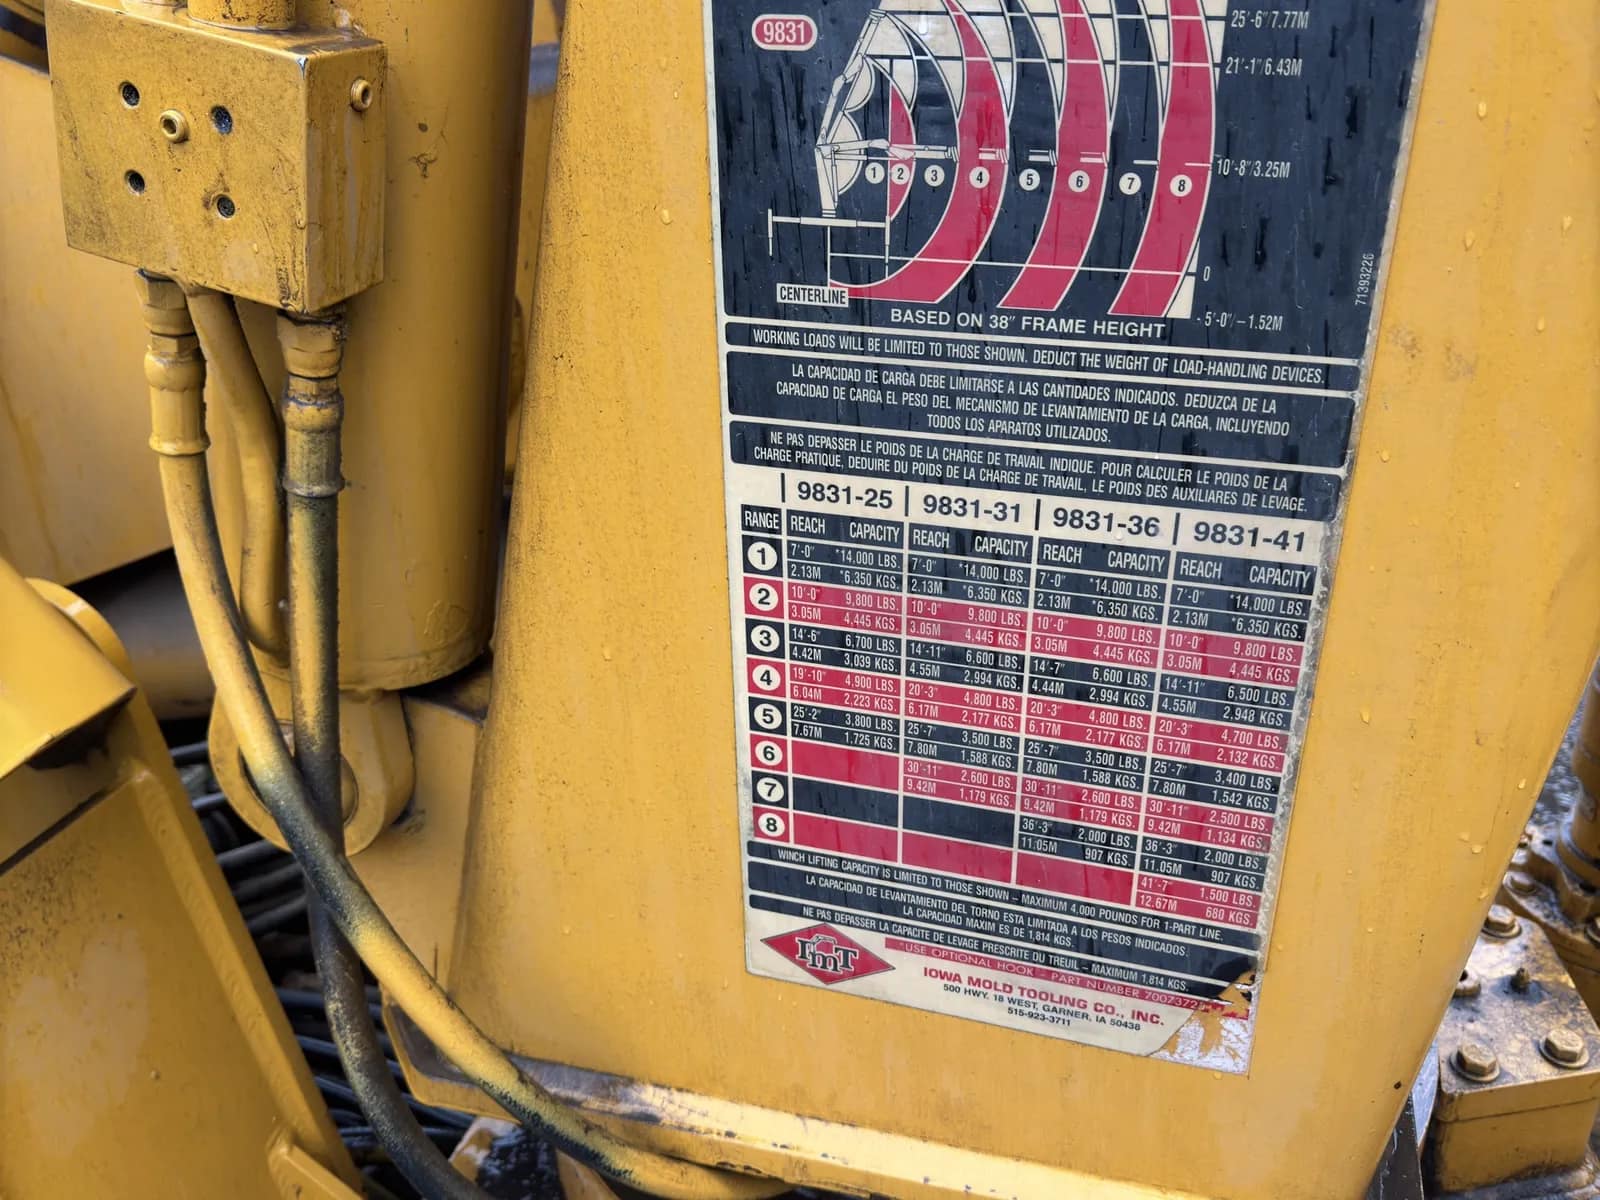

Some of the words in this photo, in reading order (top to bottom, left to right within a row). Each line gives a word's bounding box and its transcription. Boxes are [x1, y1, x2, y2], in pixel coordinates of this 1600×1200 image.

[764, 21, 806, 43] 9831
[1203, 266, 1210, 281] 0
[780, 286, 846, 305] CENTERLINE
[891, 308, 951, 325] BASED
[956, 312, 983, 328] ON
[1021, 316, 1086, 334] FRAME
[1093, 320, 1166, 338] HEIGHT
[753, 328, 800, 346] WORKING
[803, 332, 836, 349] LOADS
[838, 335, 866, 351] WILL
[867, 337, 880, 352] BE
[884, 339, 925, 355] LIMITED
[929, 342, 942, 357] TO
[946, 343, 980, 360] THOSE
[984, 344, 1028, 363] SHOWN.
[1033, 349, 1077, 366] DEDUCT
[1080, 352, 1101, 368] THE
[1105, 354, 1150, 371] WEIGHT
[1152, 357, 1169, 372] OF
[1173, 358, 1268, 380] LOAD-HANDLING
[1271, 365, 1325, 384] DEVICES.
[792, 363, 805, 378] LA
[807, 364, 861, 382] CAPACIDAD
[865, 368, 879, 384] DE
[882, 370, 916, 387] CARGA
[919, 373, 946, 389] DEBE
[949, 376, 1004, 394] LIMITARSE
[1007, 380, 1015, 394] A
[1018, 381, 1039, 396] LAS
[1043, 382, 1111, 402] CANTIDADES
[1114, 387, 1179, 406] INDICADOS.
[1184, 393, 1238, 411] DEDUZCA
[1242, 397, 1258, 412] DE
[1262, 398, 1276, 414] LA
[776, 381, 829, 399] CAPACIDAD
[832, 386, 846, 402] DE
[849, 387, 883, 403] CARGA
[886, 390, 898, 405] EL
[902, 392, 928, 408] PESO
[932, 394, 951, 409] DEL
[955, 396, 1020, 415] MECANISMO
[1023, 402, 1038, 416] DE
[1041, 403, 1130, 424] LEVANTAMIENTO
[1133, 410, 1150, 425] DE
[1152, 412, 1167, 427] LA
[1171, 412, 1212, 431] CARGA,
[1216, 417, 1290, 436] INCLUYENDO
[927, 414, 961, 430] TODOS
[965, 417, 985, 432] LOS
[988, 419, 1042, 437] APARATOS
[1045, 424, 1111, 443] UTILIZADOS.
[770, 431, 785, 445] NE
[786, 432, 805, 449] PAS
[807, 434, 857, 452] DEPASSER
[860, 439, 872, 453] LE
[875, 441, 906, 457] POIDS
[909, 444, 923, 458] DE
[926, 446, 939, 460] LA
[942, 447, 984, 464] CHARGE
[987, 451, 1001, 466] DE
[1004, 453, 1046, 470] TRAVAIL
[1050, 457, 1096, 474] INDIQUE.
[1101, 461, 1133, 478] POUR
[1136, 464, 1193, 483] CALCULER
[1196, 470, 1211, 484] LE
[1214, 471, 1250, 488] POIDS
[1253, 475, 1270, 490] DE
[1273, 477, 1287, 492] LA
[797, 481, 893, 509] 9831-25
[923, 494, 1021, 523] 9831-31
[745, 510, 779, 530] RANGE
[790, 515, 825, 534] REACH
[849, 522, 900, 543] CAPACITY
[1053, 507, 1160, 537] 9831-36
[913, 529, 950, 549] REACH
[974, 535, 1028, 557] CAPACITY
[1194, 522, 1305, 552] 9831-41
[1042, 544, 1083, 564] REACH
[1107, 550, 1166, 572] CAPACITY
[1180, 558, 1222, 580] REACH
[1249, 565, 1311, 589] CAPACITY
[778, 849, 805, 863] WINCH
[808, 854, 839, 869] LIFTING
[841, 860, 880, 876] CAPACITY
[881, 866, 891, 879] IS
[893, 870, 928, 885] LIMITED
[930, 876, 942, 888] TO
[944, 879, 973, 894] THOSE
[975, 884, 1009, 901] SHOWN
[1021, 893, 1067, 912] MAXIMUM
[1098, 908, 1138, 925] POUNDS
[1140, 916, 1160, 929] FOR
[1164, 921, 1197, 935] 1-PART
[1199, 927, 1223, 941] LINE.
[1140, 894, 1178, 912] 12.67M
[1205, 906, 1225, 921] 680
[1228, 910, 1252, 926] KGS.
[930, 948, 991, 967] OPTIONAL
[997, 962, 1034, 975] HOOK
[1051, 972, 1080, 985] PART
[1086, 980, 1140, 998] NUMBER
[924, 966, 963, 984] IOWA
[967, 976, 1014, 994] MOLD
[1017, 986, 1088, 1010] TOOLING
[1093, 1002, 1124, 1018] CO.,
[1131, 1009, 1164, 1026] INC.
[943, 983, 961, 994] 500
[964, 987, 989, 1000] HWY.
[993, 994, 1004, 1003] 18
[1007, 996, 1039, 1011] WEST,
[1042, 1004, 1092, 1022] GARNER,
[1095, 1015, 1107, 1024] IA
[1109, 1018, 1141, 1031] 50438
[1008, 1007, 1071, 1027] 515-923-3711
